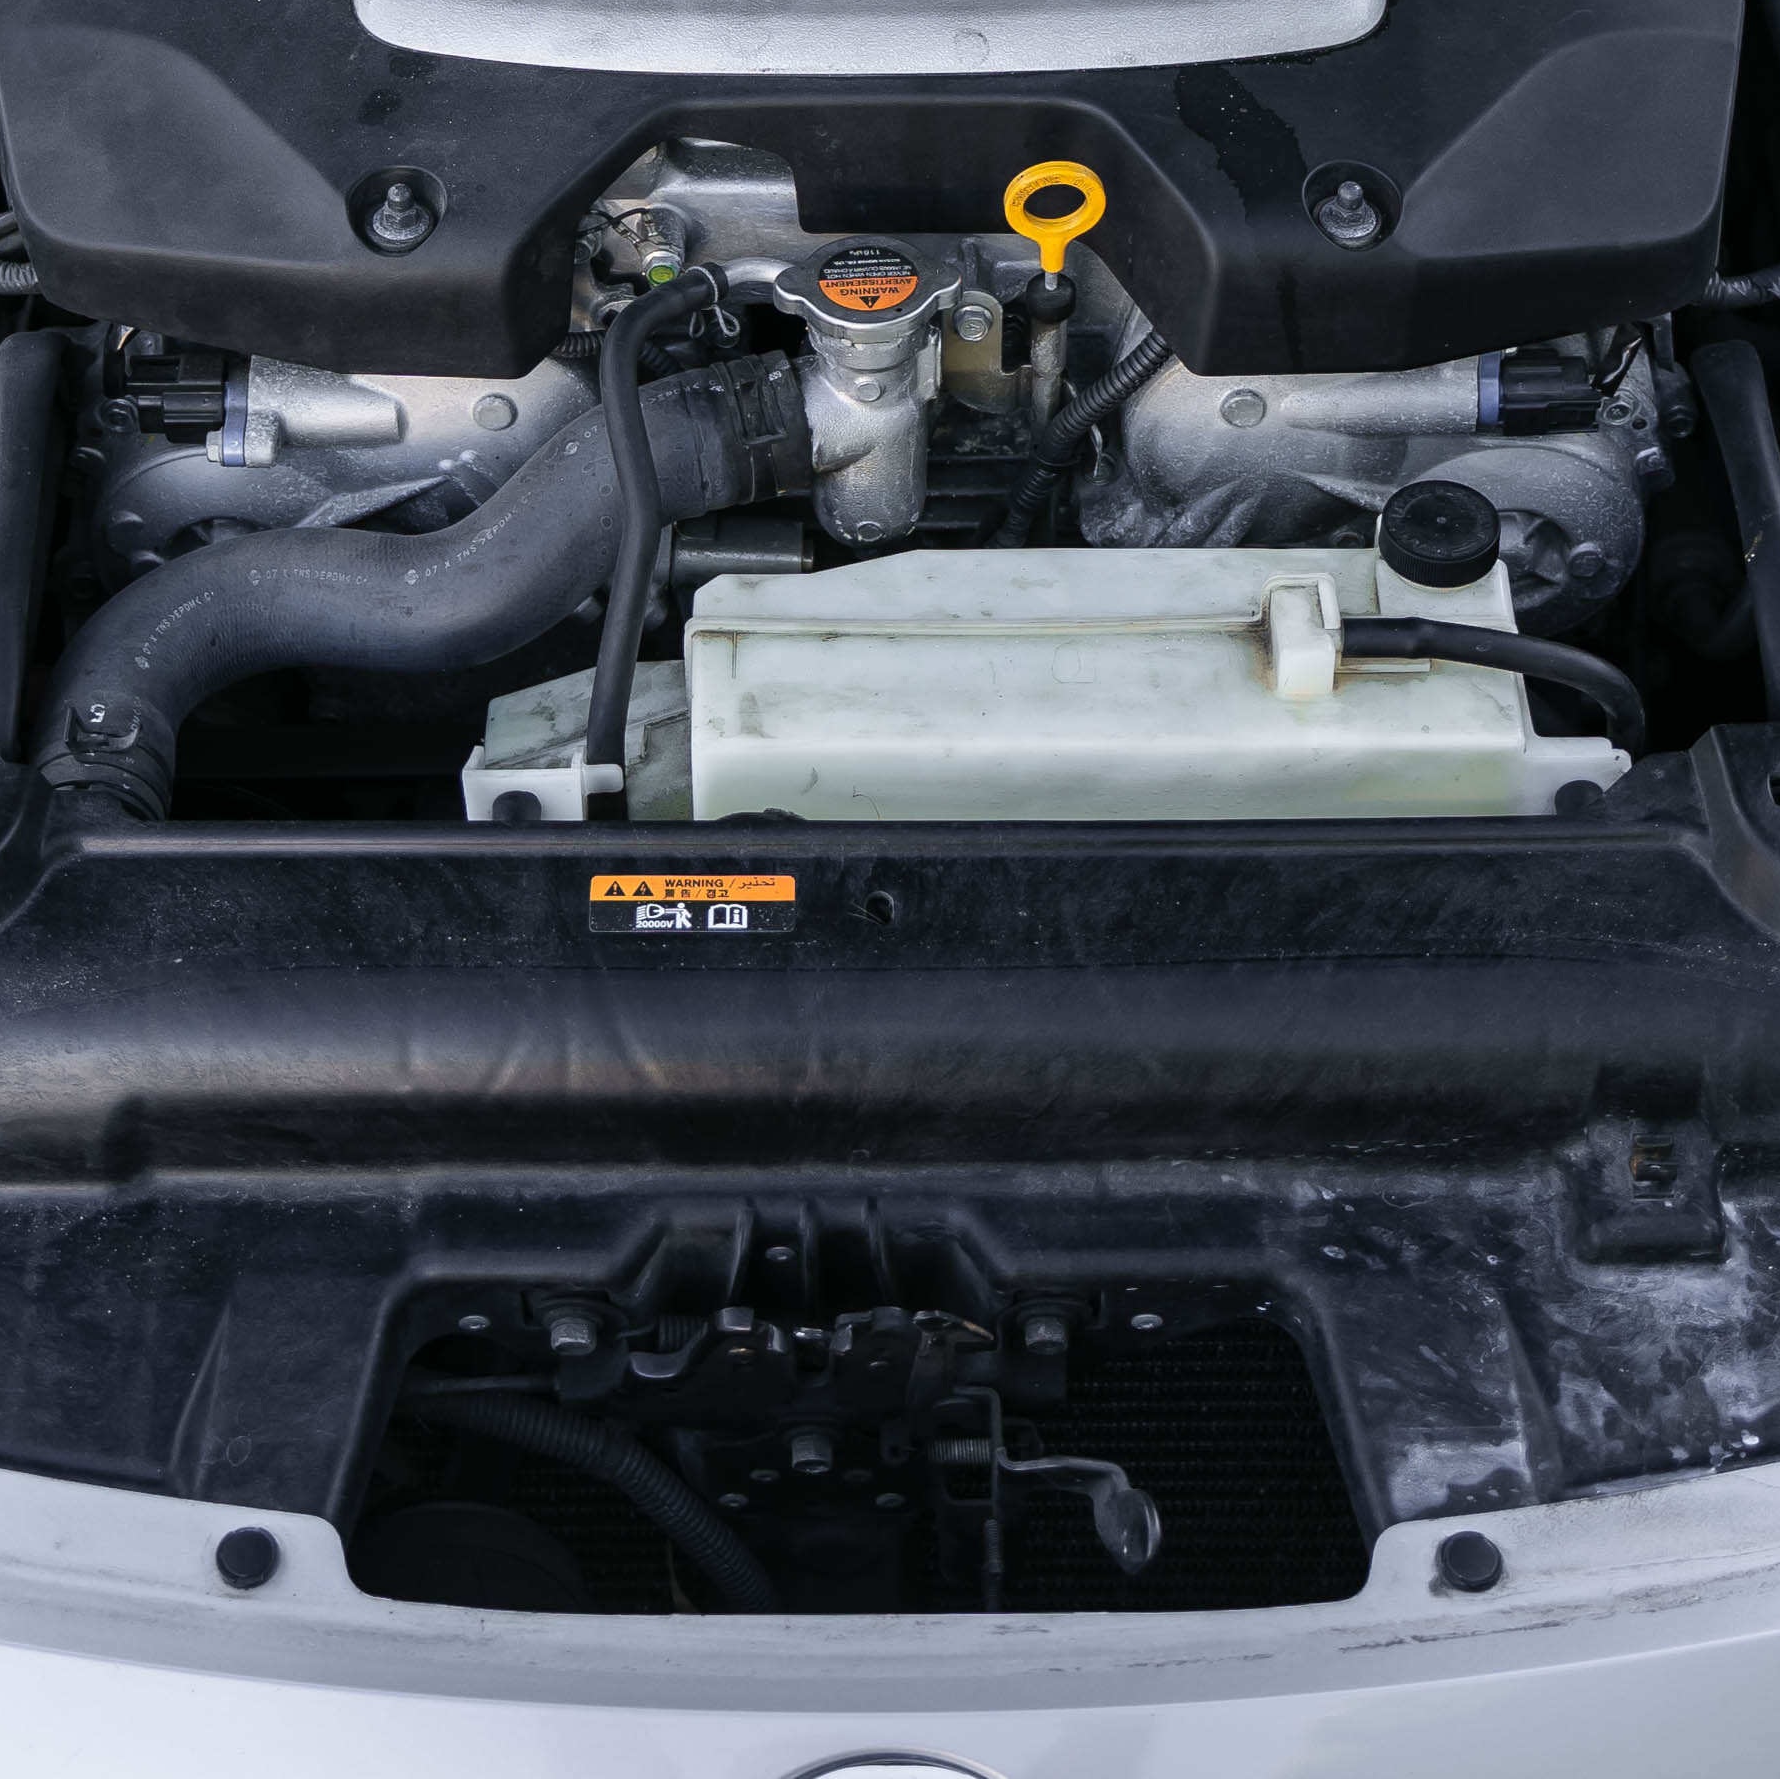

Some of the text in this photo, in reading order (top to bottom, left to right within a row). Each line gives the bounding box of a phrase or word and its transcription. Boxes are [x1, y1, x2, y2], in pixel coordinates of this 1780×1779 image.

[825, 278, 911, 288] AVERTISSEMENT
[840, 287, 899, 296] WARNING
[266, 569, 277, 579] 07
[425, 565, 437, 576] 07
[143, 642, 152, 655] 07
[665, 879, 724, 887] WARNING
[738, 877, 776, 889] تحذير
[706, 889, 730, 898] 경고
[636, 920, 674, 928] 20000V
